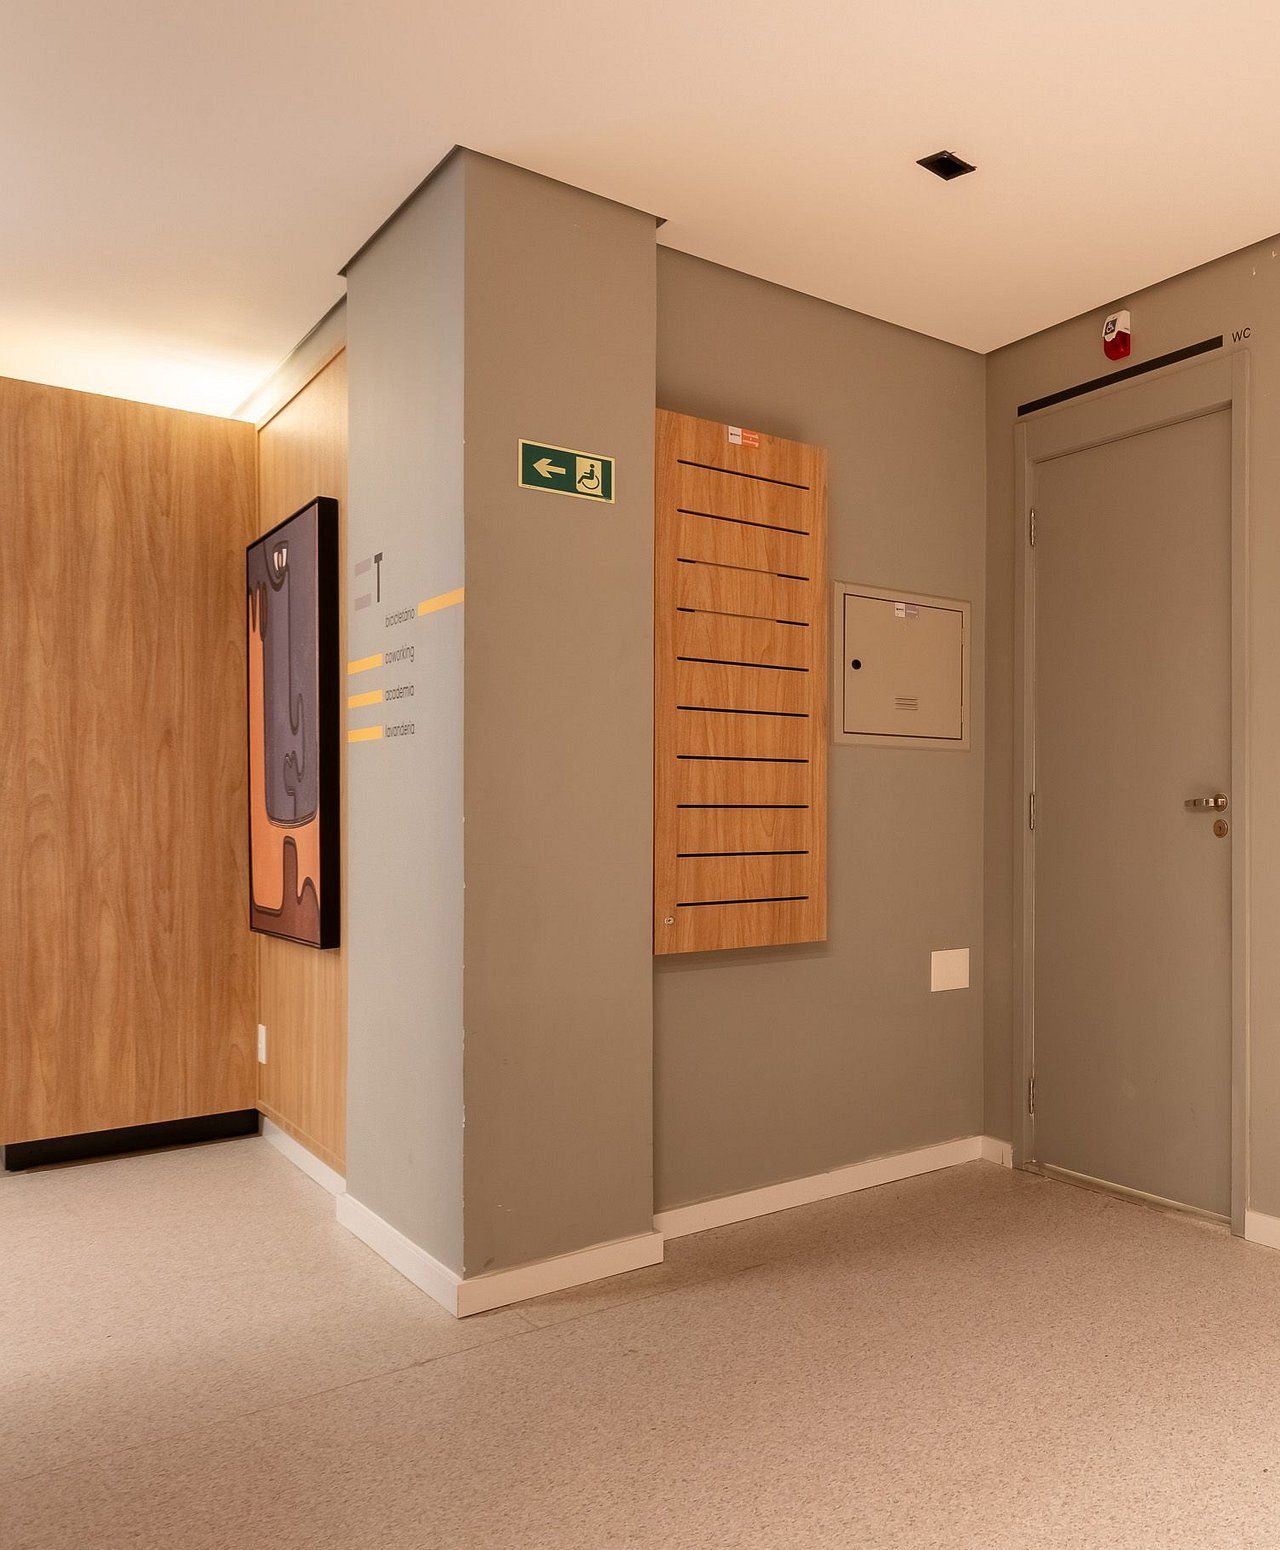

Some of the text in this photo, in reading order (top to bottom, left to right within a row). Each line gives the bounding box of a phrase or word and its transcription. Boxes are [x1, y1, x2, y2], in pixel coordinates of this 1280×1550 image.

[1231, 327, 1252, 343] WC
[384, 644, 415, 664] coworking
[384, 682, 415, 702] academia
